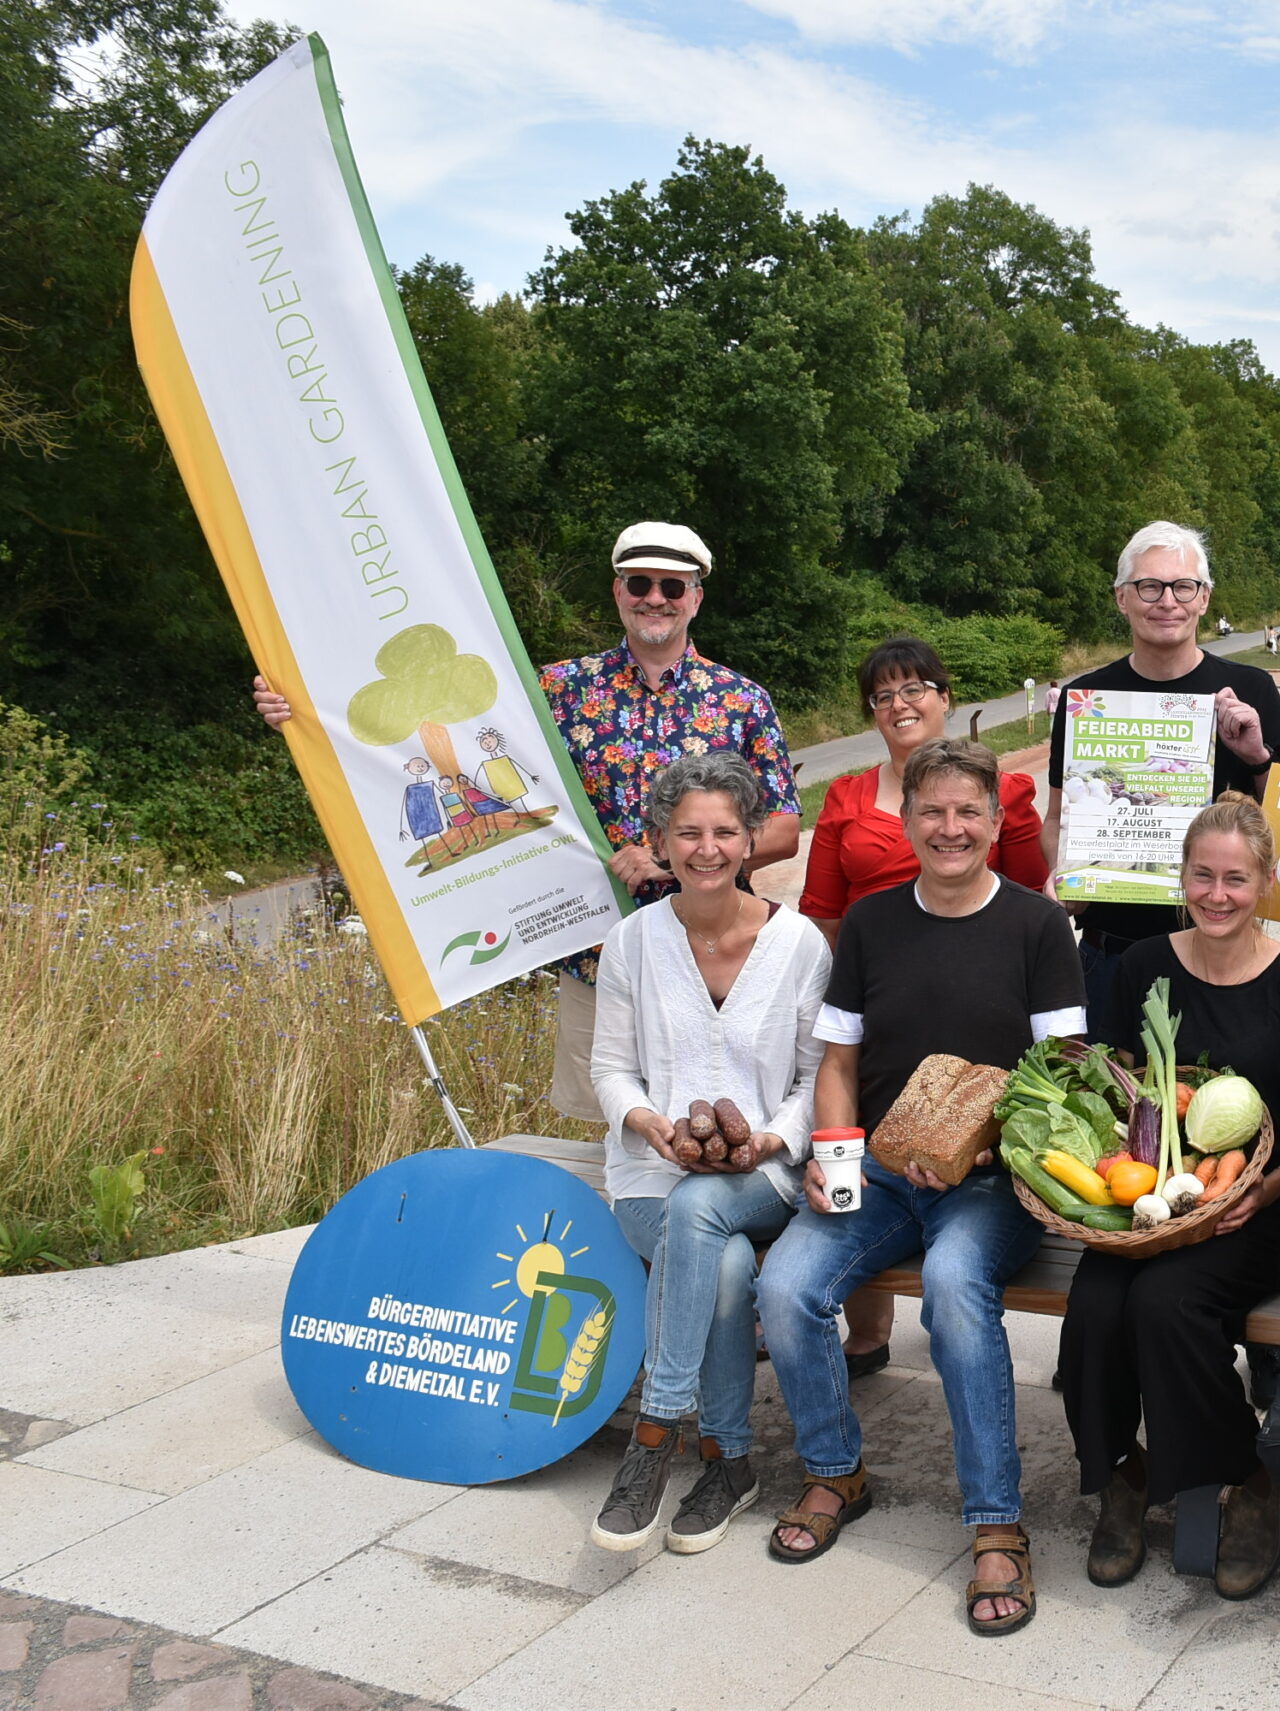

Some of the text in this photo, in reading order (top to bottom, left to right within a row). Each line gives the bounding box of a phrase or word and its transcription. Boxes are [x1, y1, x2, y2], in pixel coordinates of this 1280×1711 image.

[225, 160, 408, 620] URBAN GARDENING
[1078, 721, 1190, 738] FEIERABEND
[1076, 743, 1141, 759] MARKT
[1127, 774, 1206, 783] ENTDECKEN SIE DIE
[1127, 784, 1205, 793] VIELFALT UNSERER
[1117, 807, 1153, 816] 27. JULI
[1170, 795, 1206, 804] REGION!
[1097, 829, 1171, 839] 28. SEPTEMBER
[1107, 818, 1163, 827] 17. AUGUST
[410, 834, 578, 908] Umwelt-Bildungs-Initiative OWL
[514, 895, 584, 931] STIFTUNG UMWELT
[518, 903, 589, 938] UND ENTWICKLUNG
[522, 904, 610, 945] NORDRHEIN-WESTFALEN
[368, 1294, 518, 1344] BÜRGERINITIATIVE
[290, 1315, 510, 1375] LEBENSWERTES BÖRDELAND
[365, 1360, 499, 1407] & DIEMELTAL E.V.
